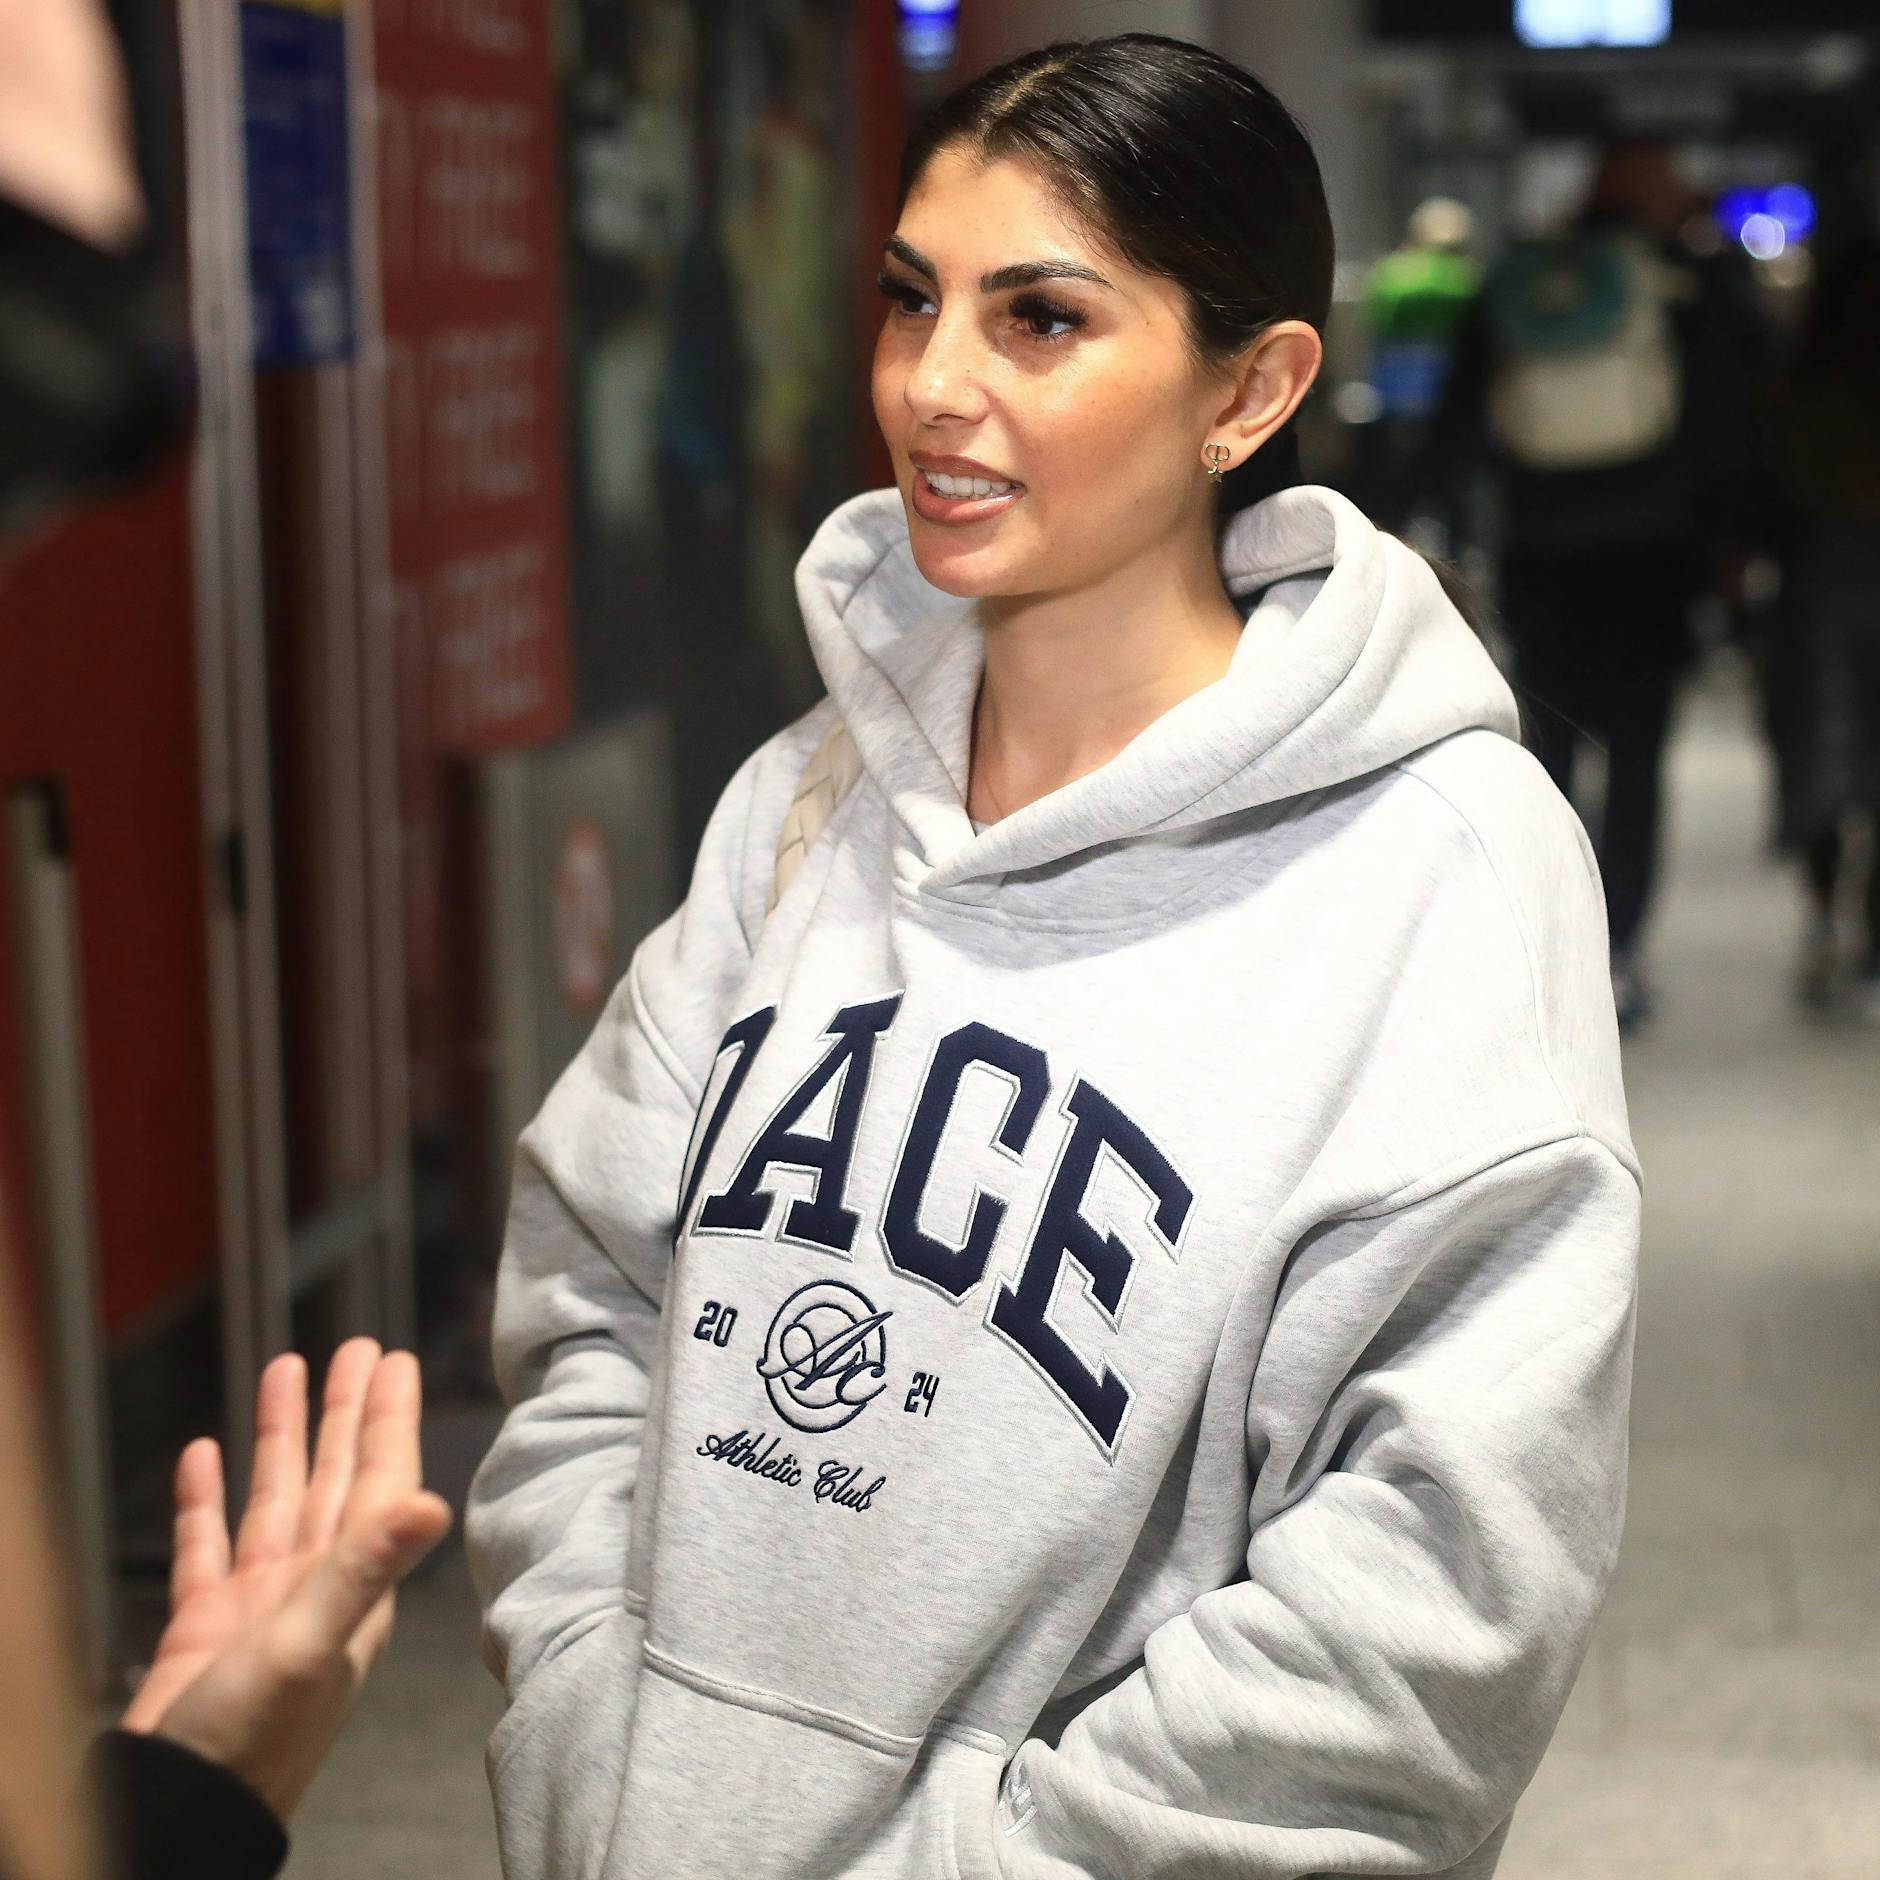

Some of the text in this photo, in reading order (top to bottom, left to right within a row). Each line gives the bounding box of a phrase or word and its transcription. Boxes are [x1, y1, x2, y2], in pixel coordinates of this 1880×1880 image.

[693, 1299, 738, 1348] 20
[903, 1371, 939, 1418] 24
[696, 1430, 887, 1513] Athletic Club
